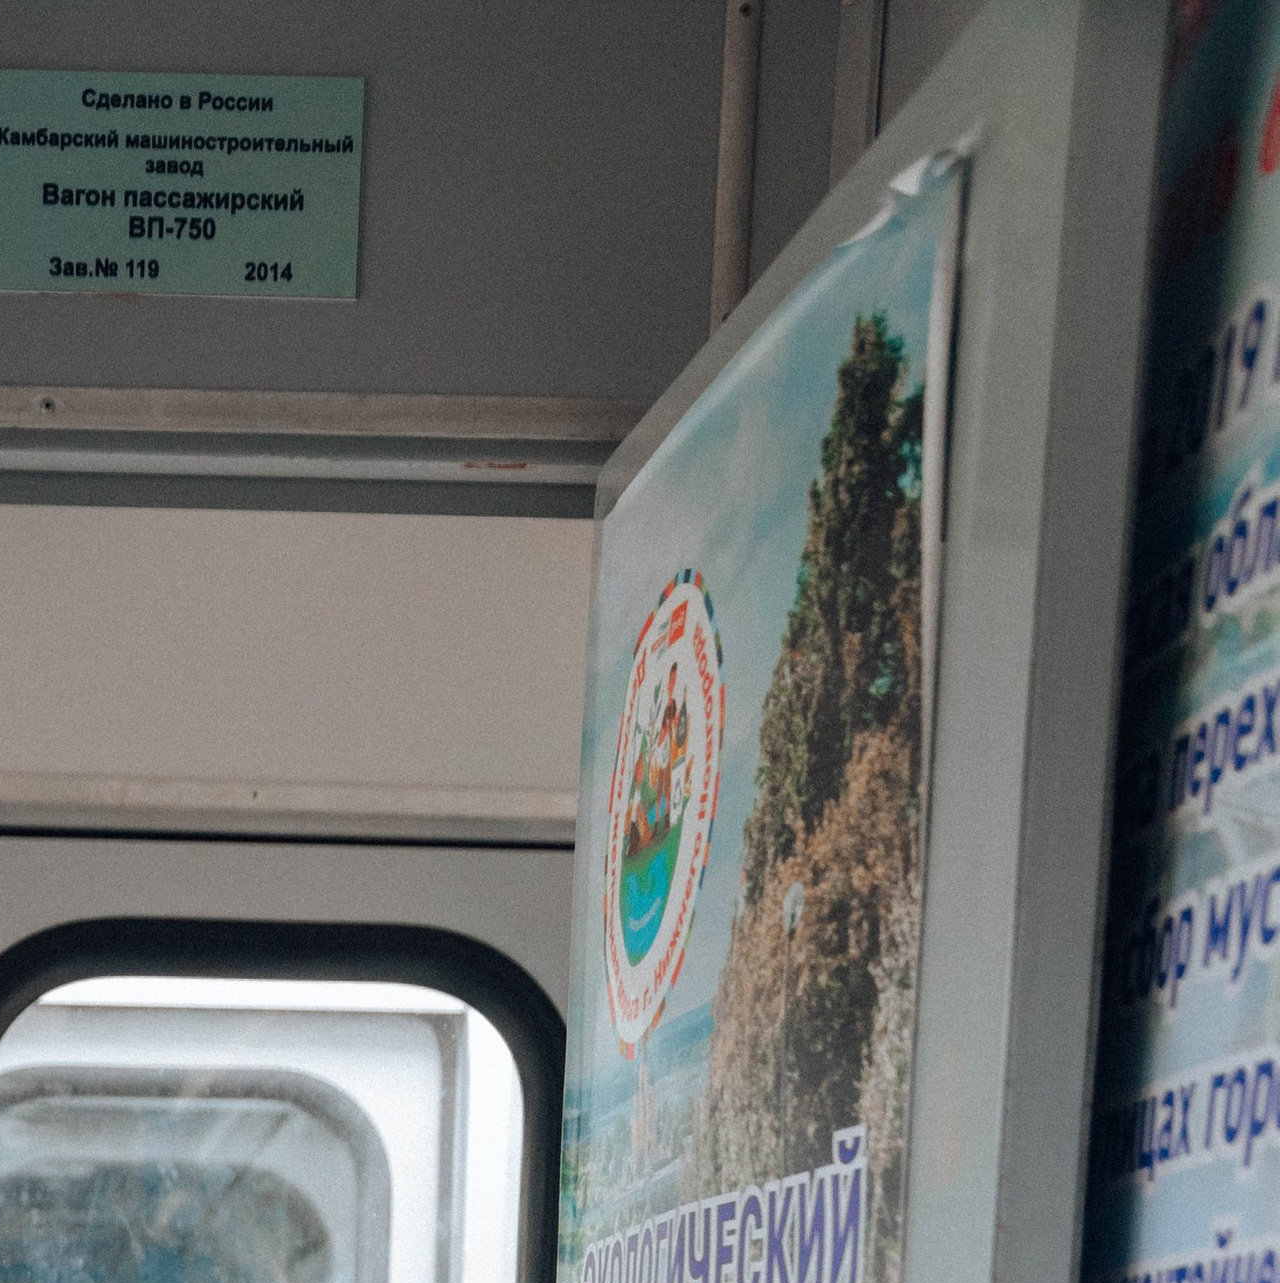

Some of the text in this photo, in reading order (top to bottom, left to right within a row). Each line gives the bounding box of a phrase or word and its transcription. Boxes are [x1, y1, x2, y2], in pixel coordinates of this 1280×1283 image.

[81, 88, 274, 112] Сделано в России
[125, 133, 354, 154] машиностроительный
[145, 158, 204, 178] завод
[42, 183, 304, 215] Вагон пассажирский
[128, 216, 216, 241] ВП-750
[126, 260, 160, 279] 119
[244, 262, 293, 283] 2014
[1206, 1060, 1280, 1168] гор
